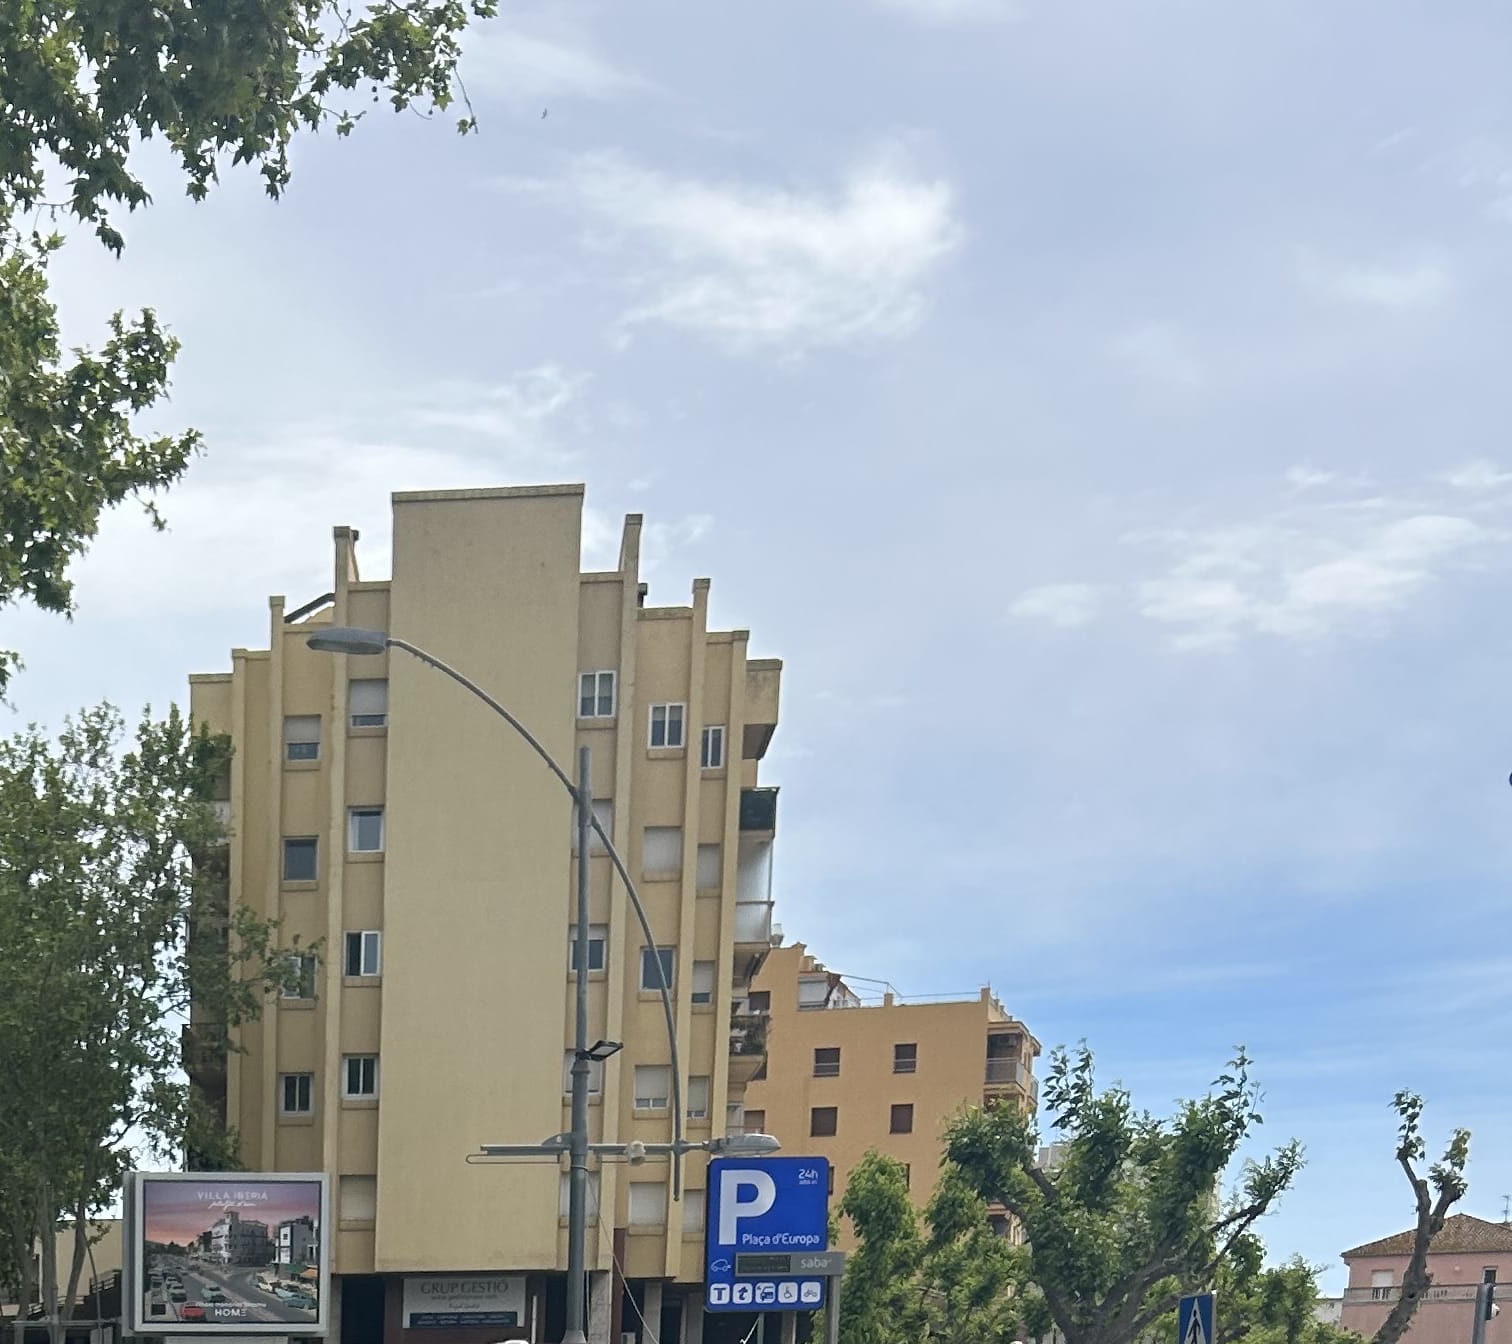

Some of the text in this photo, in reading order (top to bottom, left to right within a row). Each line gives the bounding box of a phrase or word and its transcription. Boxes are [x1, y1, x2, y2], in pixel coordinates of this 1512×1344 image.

[798, 1168, 818, 1179] 24h
[197, 1191, 268, 1201] VILLA IBERIA
[719, 1169, 776, 1245] P
[742, 1232, 820, 1247] Plaça d'Europa
[800, 1256, 828, 1269] saba
[420, 1279, 509, 1294] GRUP GESTIÓ
[214, 1308, 247, 1317] HOME
